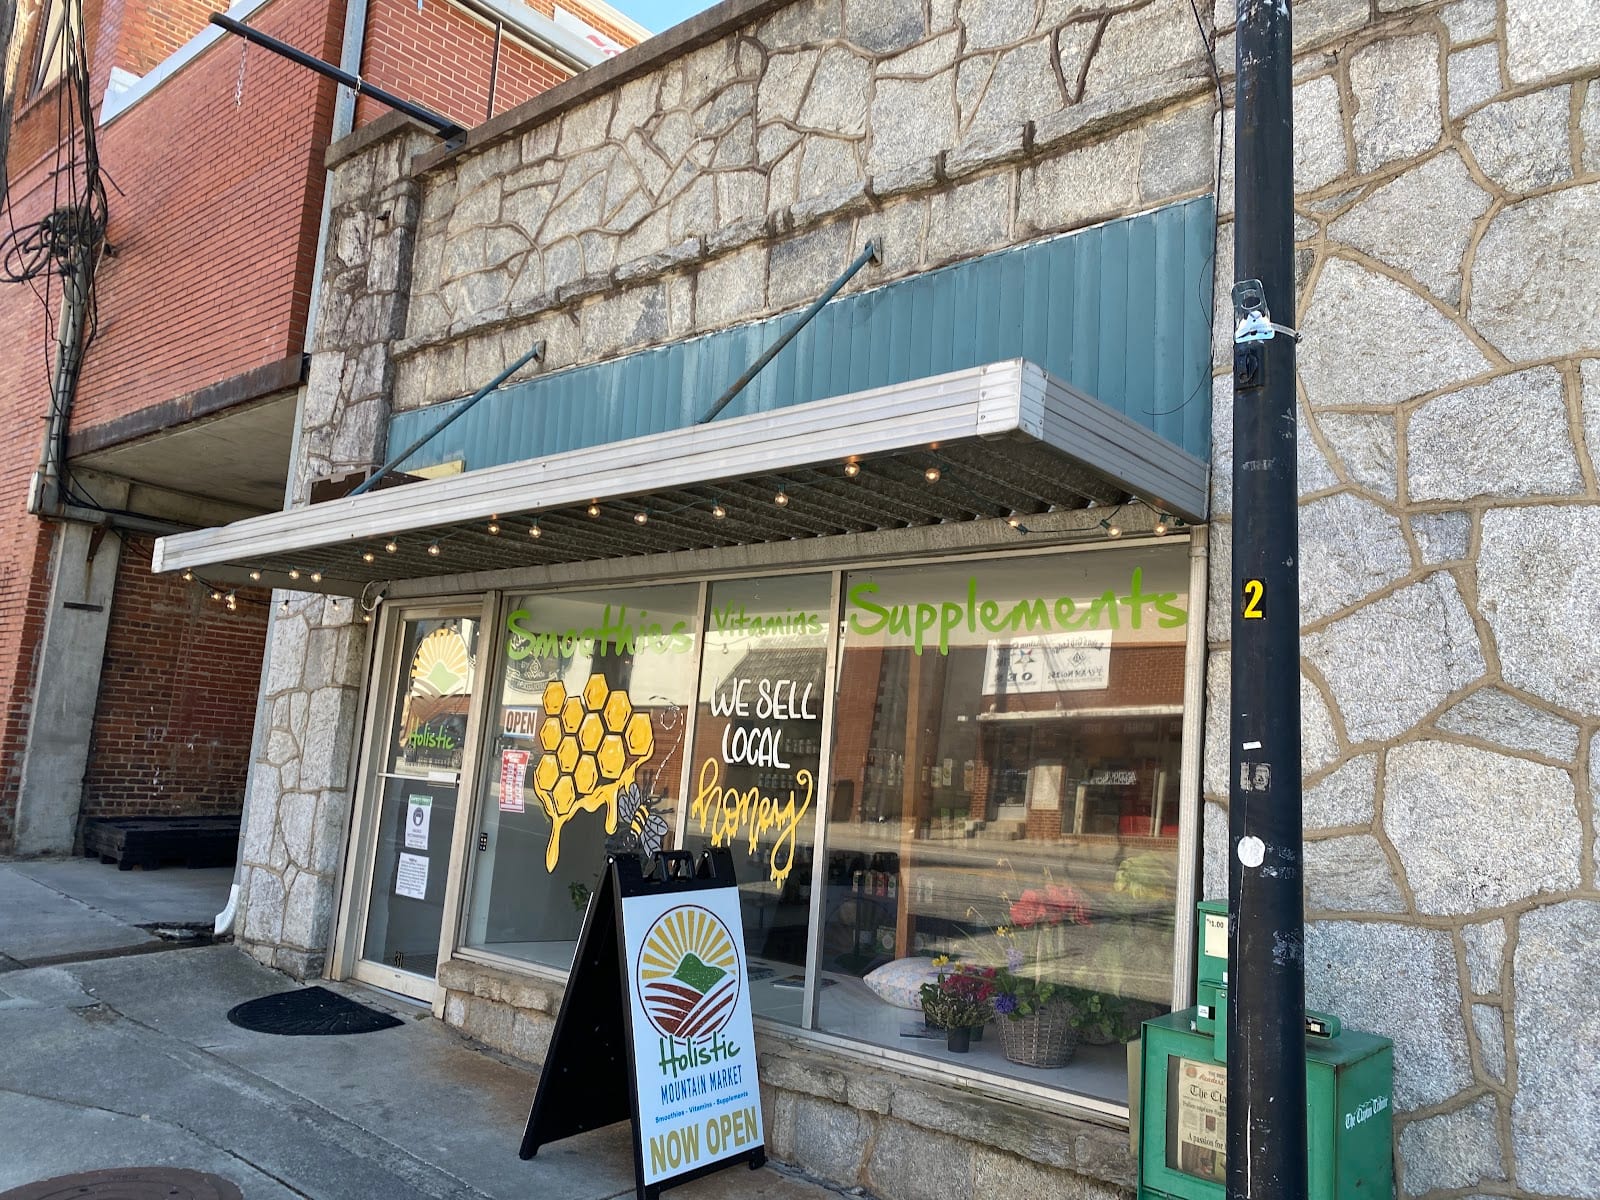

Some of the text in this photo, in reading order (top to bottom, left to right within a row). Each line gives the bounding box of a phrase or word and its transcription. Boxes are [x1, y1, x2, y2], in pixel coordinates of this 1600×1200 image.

[713, 600, 823, 637] Vitamins
[849, 567, 1188, 656] Supplements
[1244, 579, 1264, 618] 2
[507, 603, 693, 660] Smoothies
[711, 677, 816, 720] WE SELL
[408, 722, 455, 750] Holistic
[505, 710, 536, 734] OPEN
[721, 723, 790, 769] LOCAL
[691, 757, 813, 889] honey
[658, 1031, 741, 1079] Holistic
[661, 1065, 743, 1105] MOUNTAIN MARKET
[1190, 1084, 1227, 1104] The Cla
[655, 1110, 685, 1123] Smoothies
[689, 1102, 713, 1113] Vitamins
[716, 1091, 749, 1105] Supplements
[650, 1106, 758, 1176] NOW OPEN
